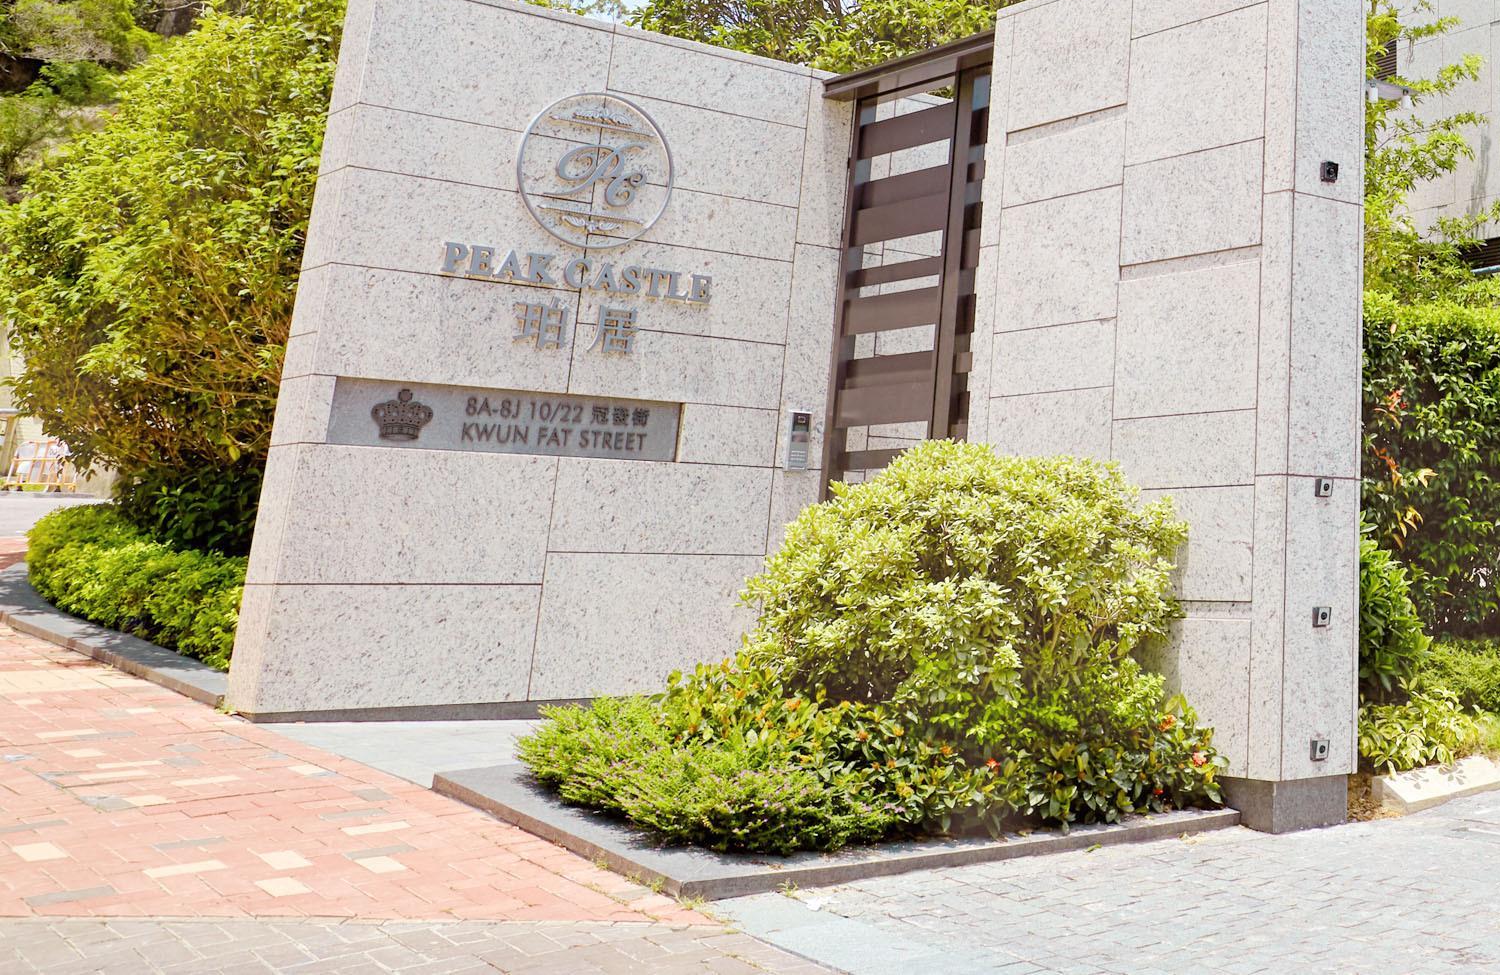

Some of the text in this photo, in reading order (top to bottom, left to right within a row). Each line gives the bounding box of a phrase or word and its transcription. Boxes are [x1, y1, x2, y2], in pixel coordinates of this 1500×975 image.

[440, 241, 713, 304] PEAK CASTLE
[512, 297, 640, 354] 珀居
[465, 397, 521, 420] 8A-8J
[529, 401, 583, 424] 10/22
[460, 422, 648, 451] KWUN FAT STREET
